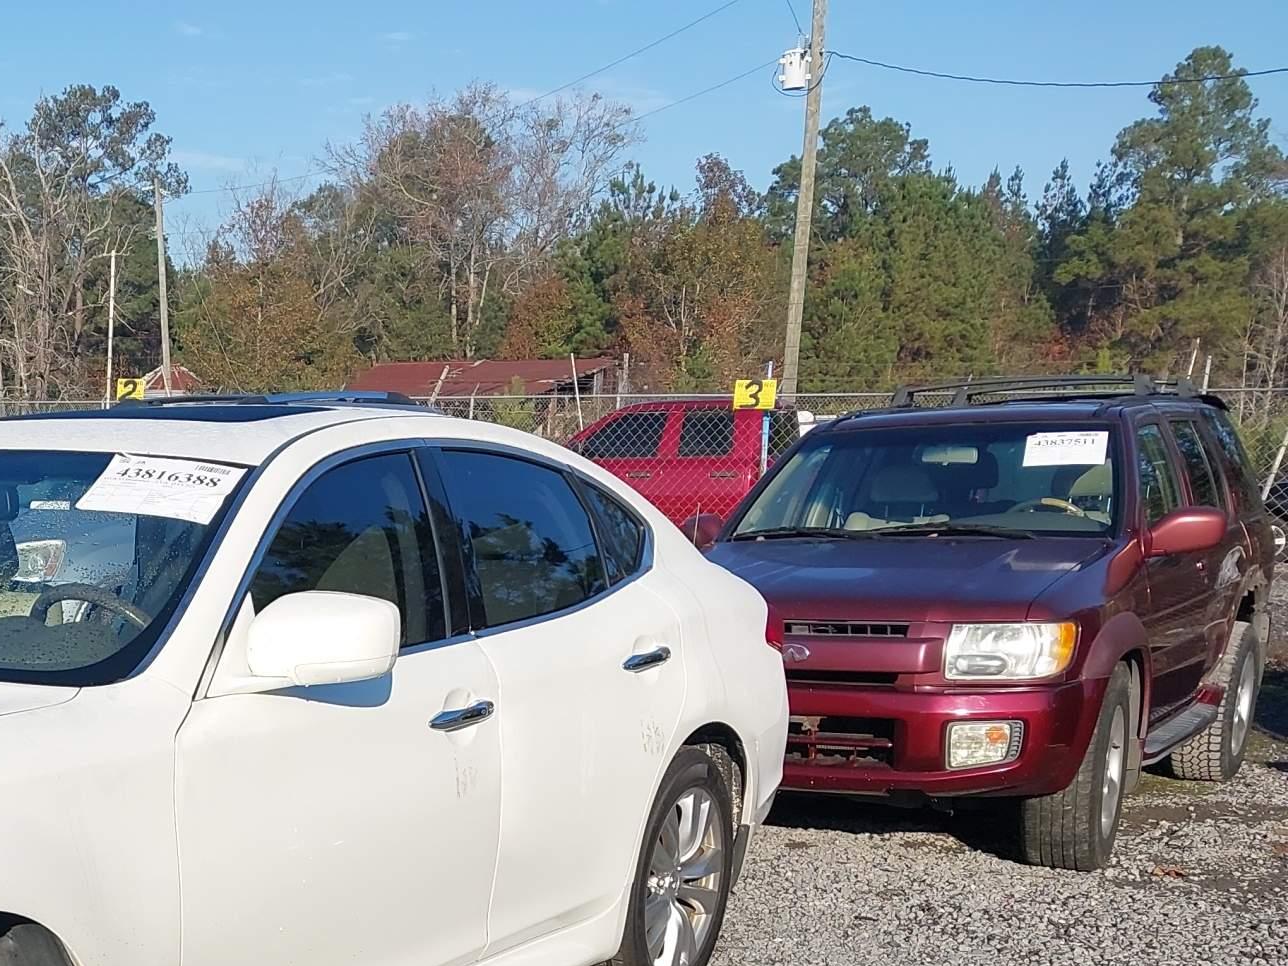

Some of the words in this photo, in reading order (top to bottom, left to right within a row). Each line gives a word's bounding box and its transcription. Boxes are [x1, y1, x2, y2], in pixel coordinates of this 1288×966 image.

[119, 379, 138, 401] 2
[739, 377, 763, 408] 3
[116, 467, 222, 488] 43816388
